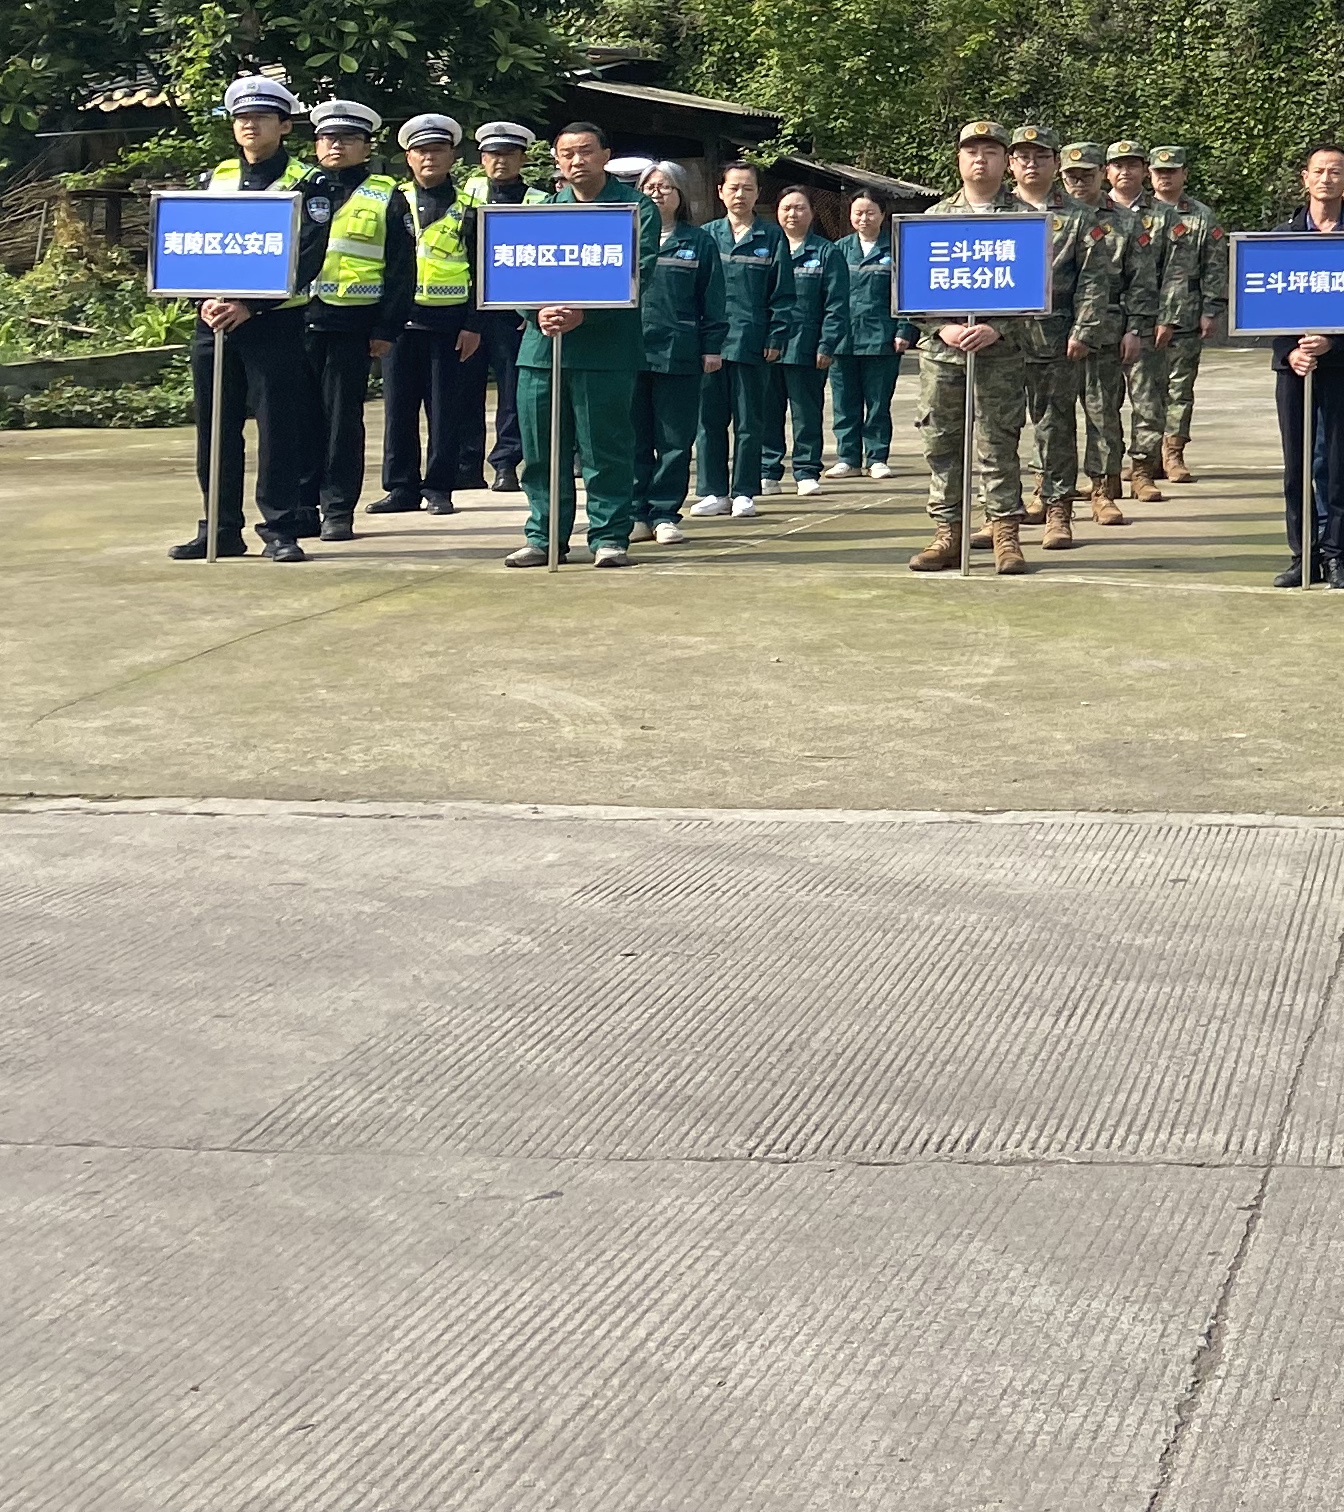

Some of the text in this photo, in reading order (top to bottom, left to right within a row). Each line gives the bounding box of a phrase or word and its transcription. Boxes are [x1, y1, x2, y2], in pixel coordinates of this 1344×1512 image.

[163, 231, 284, 256] 夷陵区公安局
[494, 243, 623, 266] 夷陵区卫健局
[929, 239, 1015, 262] 三斗坪镇
[930, 266, 1015, 289] 民兵分队
